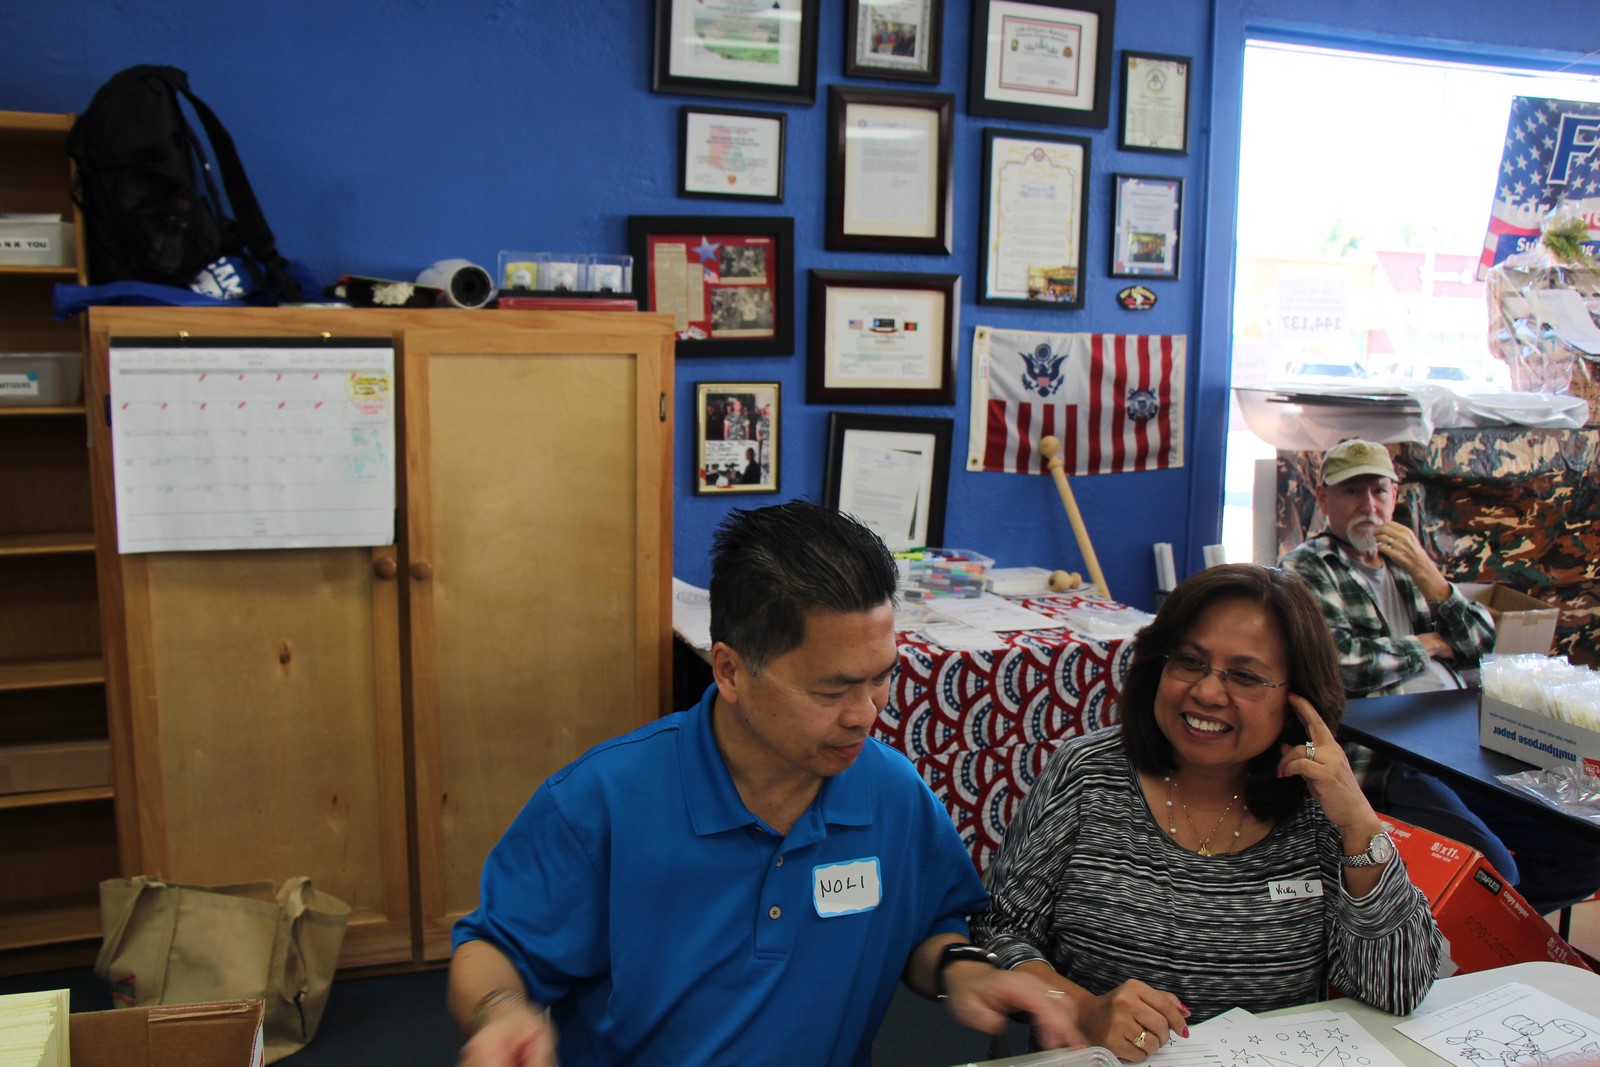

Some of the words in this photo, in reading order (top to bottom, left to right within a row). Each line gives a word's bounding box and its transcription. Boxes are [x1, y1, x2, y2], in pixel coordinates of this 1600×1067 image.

[1493, 726, 1517, 741] paper
[1518, 735, 1577, 762] multipurpose
[820, 875, 865, 898] NOLI
[1476, 870, 1500, 892] STAPLES
[1503, 891, 1516, 905] copy
[1514, 902, 1529, 918] paper
